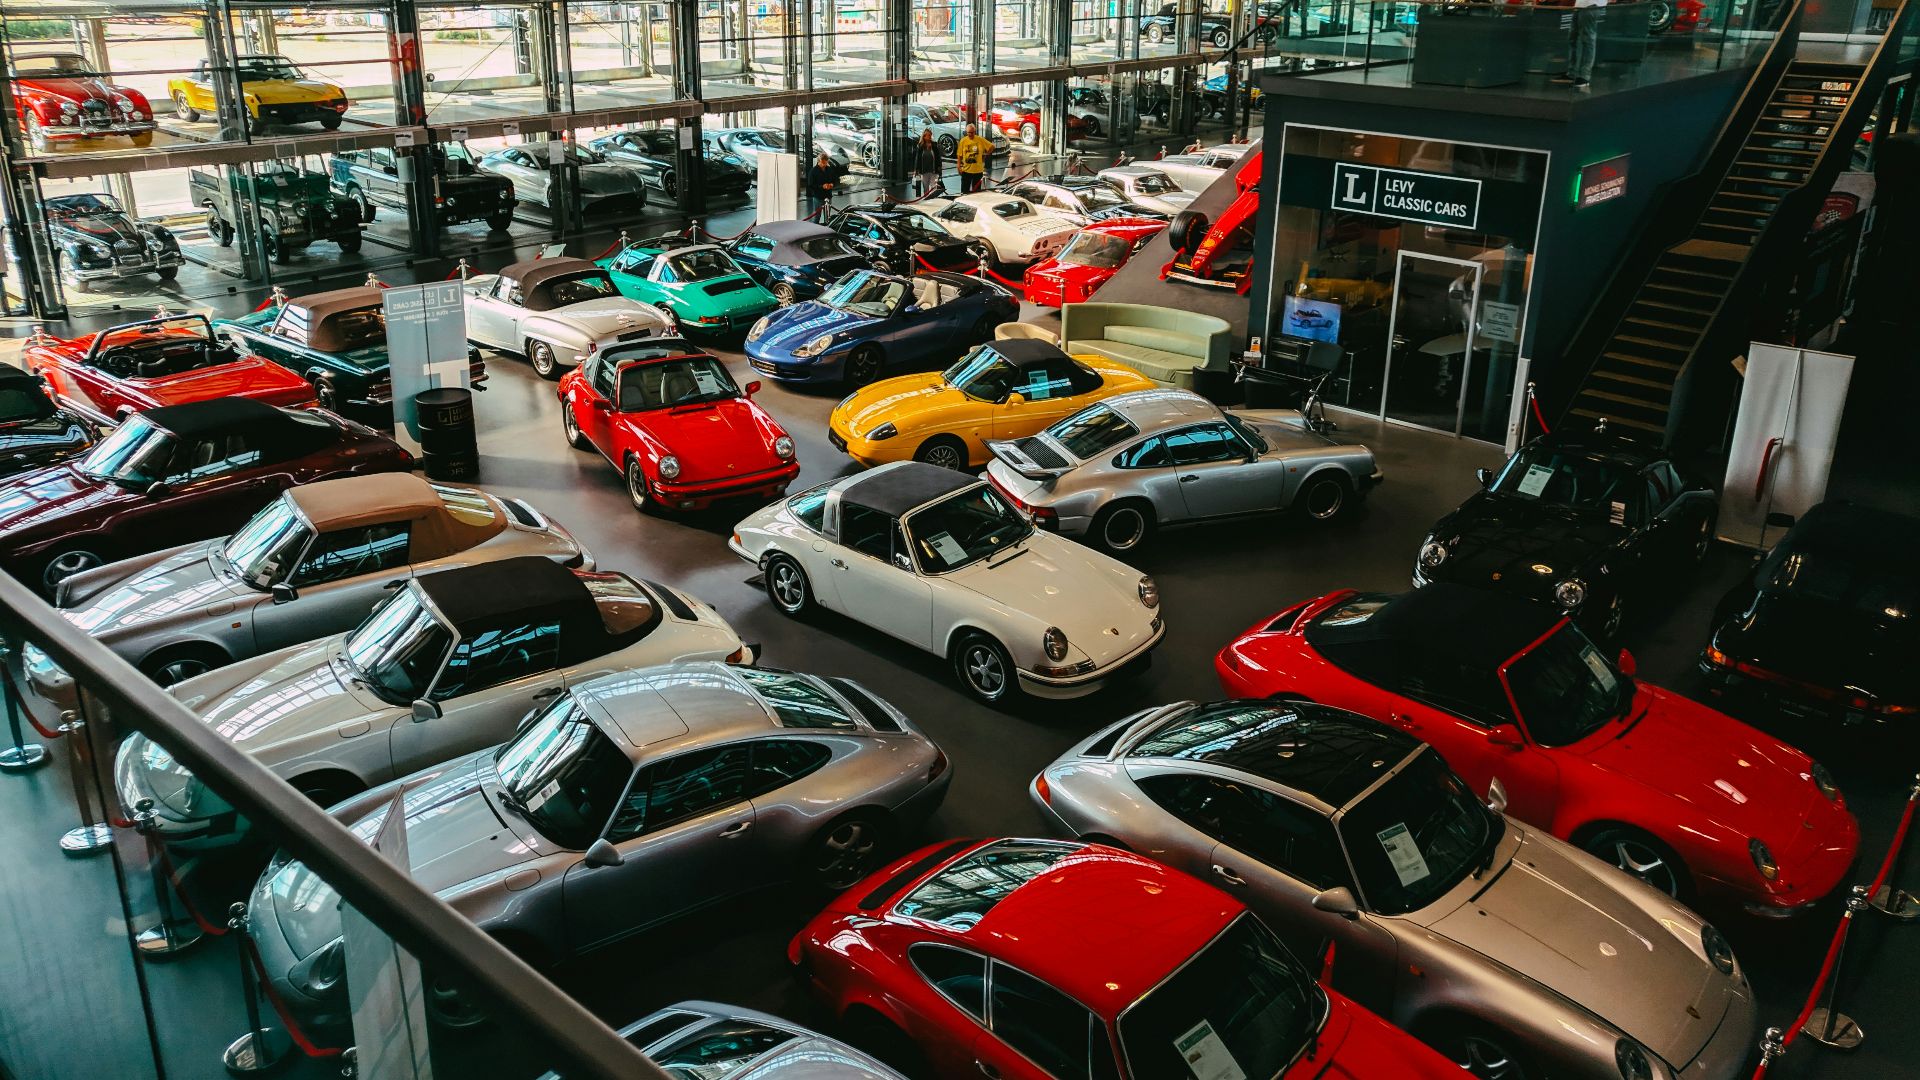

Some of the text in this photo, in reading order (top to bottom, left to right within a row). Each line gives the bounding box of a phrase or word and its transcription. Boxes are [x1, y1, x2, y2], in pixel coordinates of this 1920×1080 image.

[1342, 173, 1366, 204] L
[1385, 178, 1415, 194] LEVY
[1383, 195, 1467, 218] CLASSIC CARS
